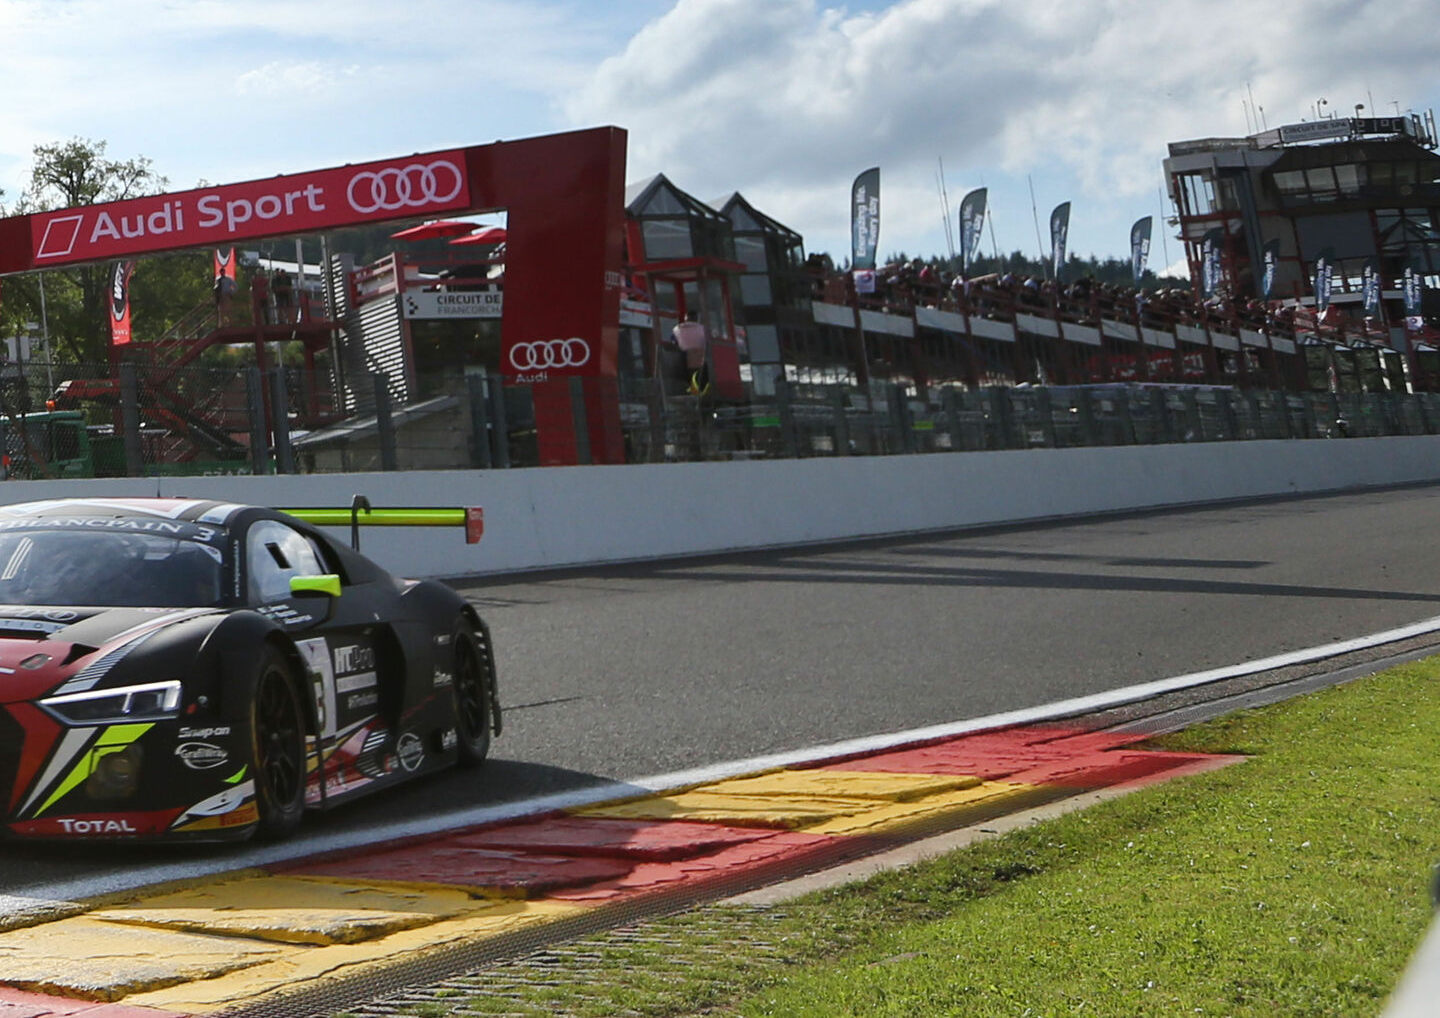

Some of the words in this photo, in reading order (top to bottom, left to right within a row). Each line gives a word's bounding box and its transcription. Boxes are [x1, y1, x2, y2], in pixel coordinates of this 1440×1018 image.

[89, 200, 184, 243] Audi
[197, 184, 326, 232] Sport
[437, 295, 481, 304] CIRCUIT
[485, 294, 501, 304] DE
[515, 373, 548, 384] Audi
[7, 518, 183, 533] BLANCPAIN
[193, 526, 216, 541] 3
[178, 727, 230, 738] Snap-on
[57, 818, 137, 833] TOTAL
